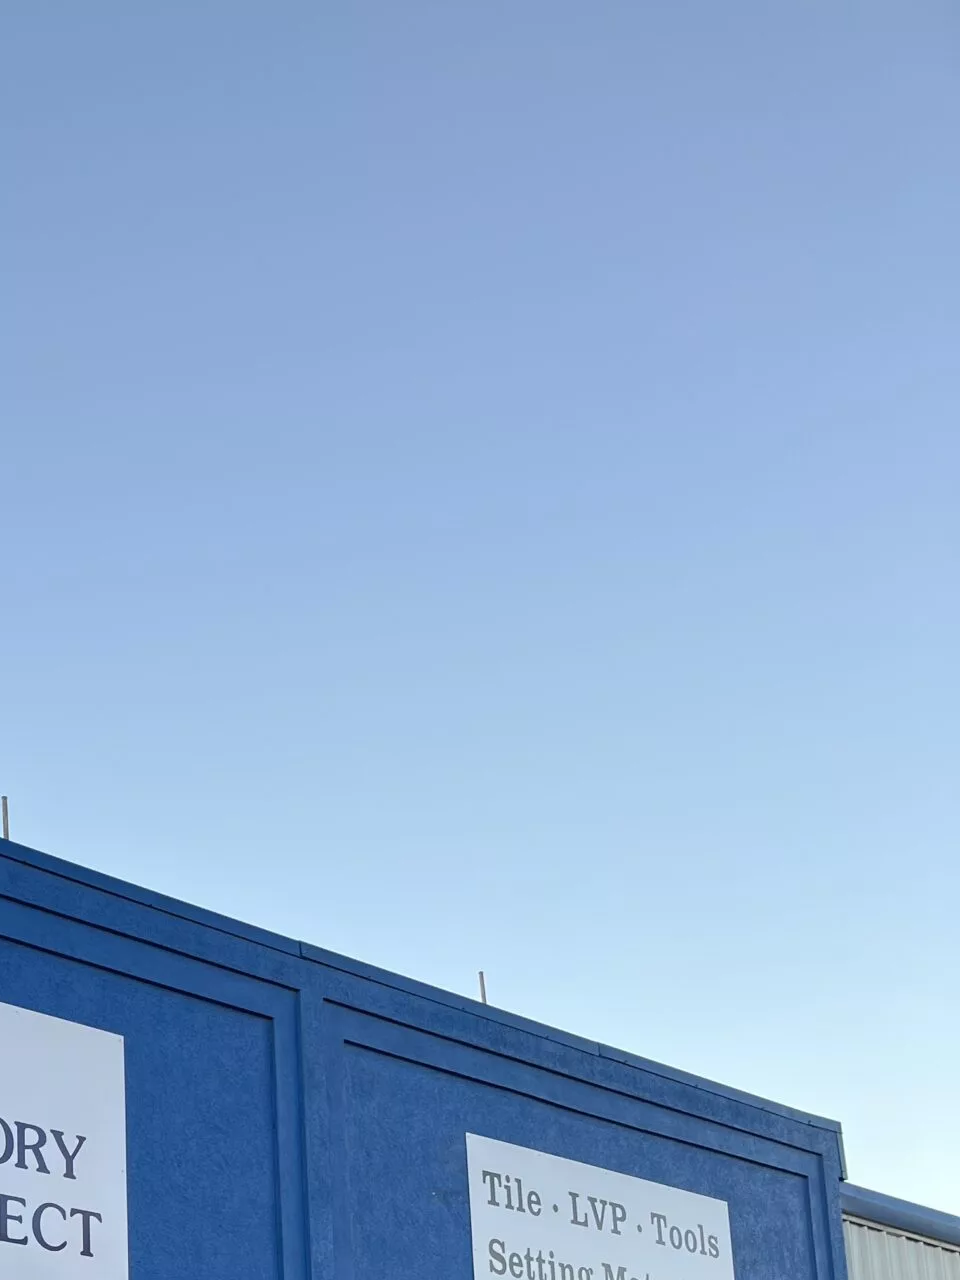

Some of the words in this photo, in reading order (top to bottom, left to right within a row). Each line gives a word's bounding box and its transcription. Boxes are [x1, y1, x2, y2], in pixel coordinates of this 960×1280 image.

[482, 1170, 542, 1217] Tile
[568, 1191, 627, 1236] LVP
[650, 1211, 720, 1259] Tools
